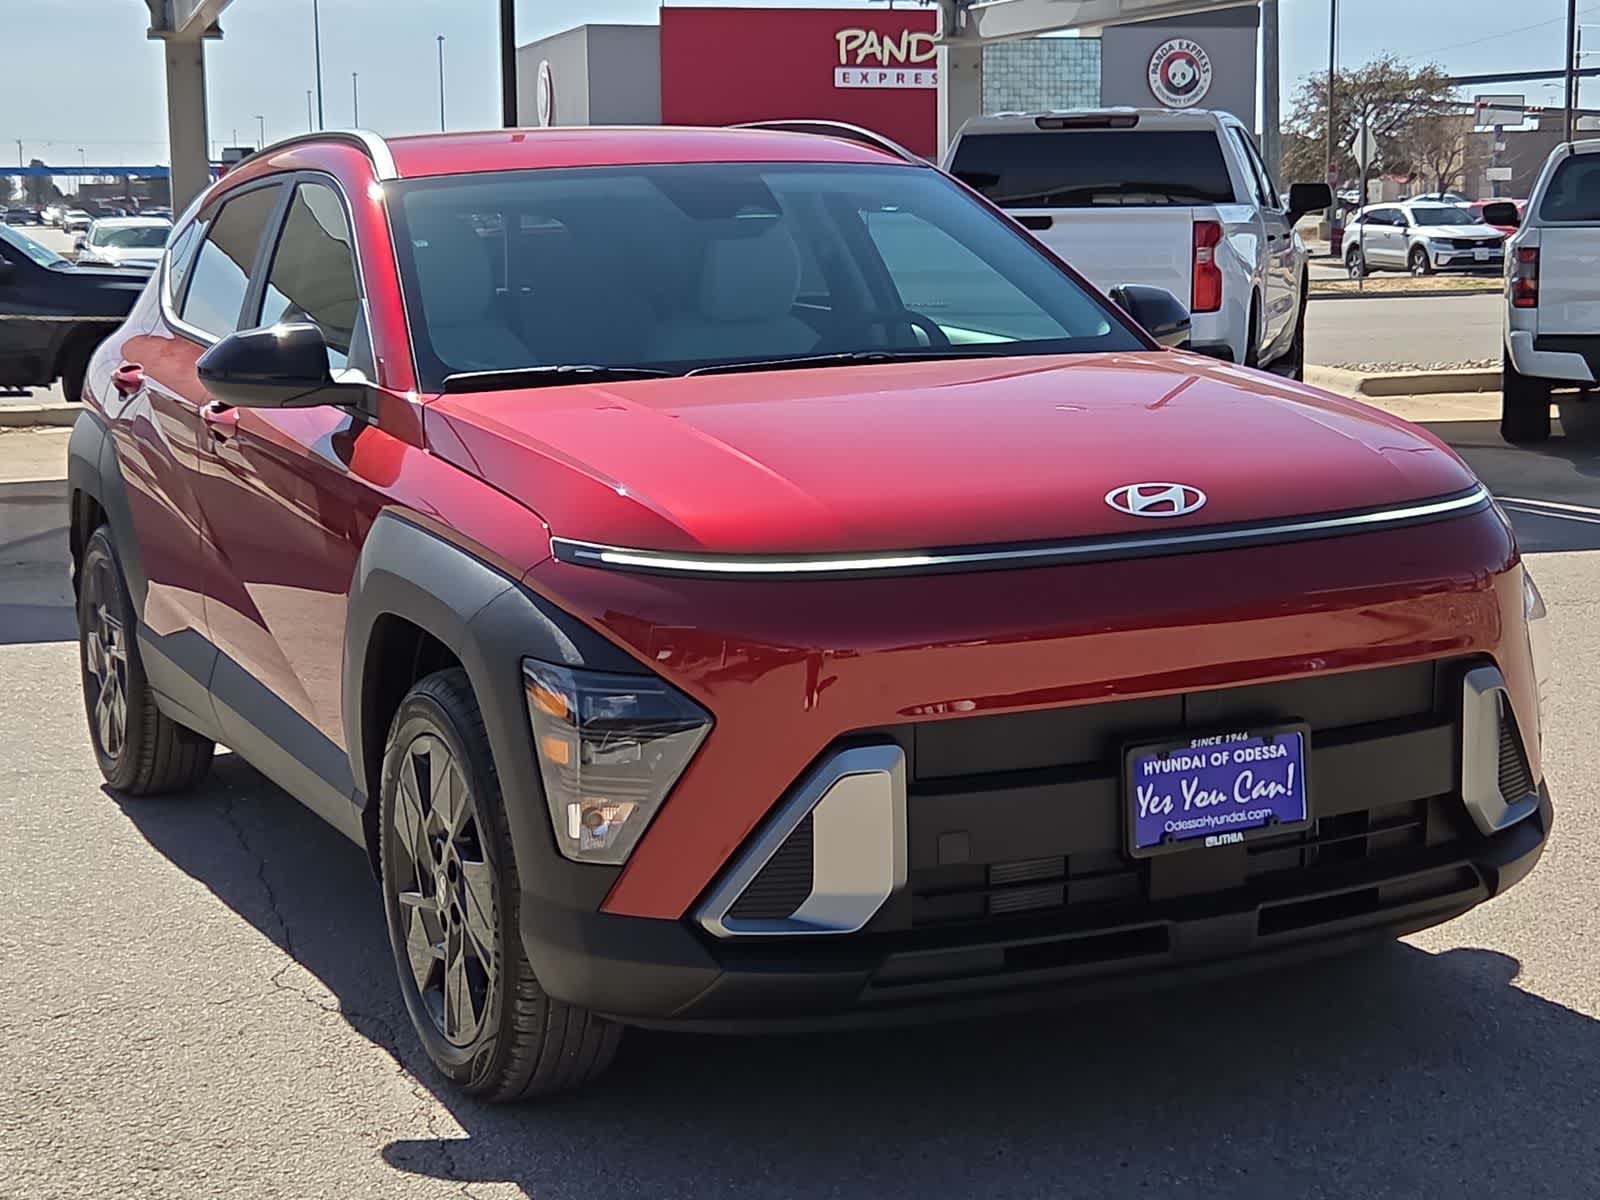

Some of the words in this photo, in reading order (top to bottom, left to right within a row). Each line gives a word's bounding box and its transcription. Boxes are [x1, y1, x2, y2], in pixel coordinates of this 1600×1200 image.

[1151, 43, 1175, 75] PANDA
[1178, 41, 1210, 74] EXPRESS
[1191, 736, 1222, 749] SINCE
[1225, 731, 1249, 744] 1946
[1144, 755, 1206, 776] HYUNDAI
[1210, 751, 1230, 766] OF
[1233, 743, 1287, 763] ODESSA
[1136, 783, 1174, 818] Yes
[1180, 776, 1228, 811] You
[1233, 762, 1295, 804] Can!
[1164, 807, 1273, 833] OdessaHyundai.com
